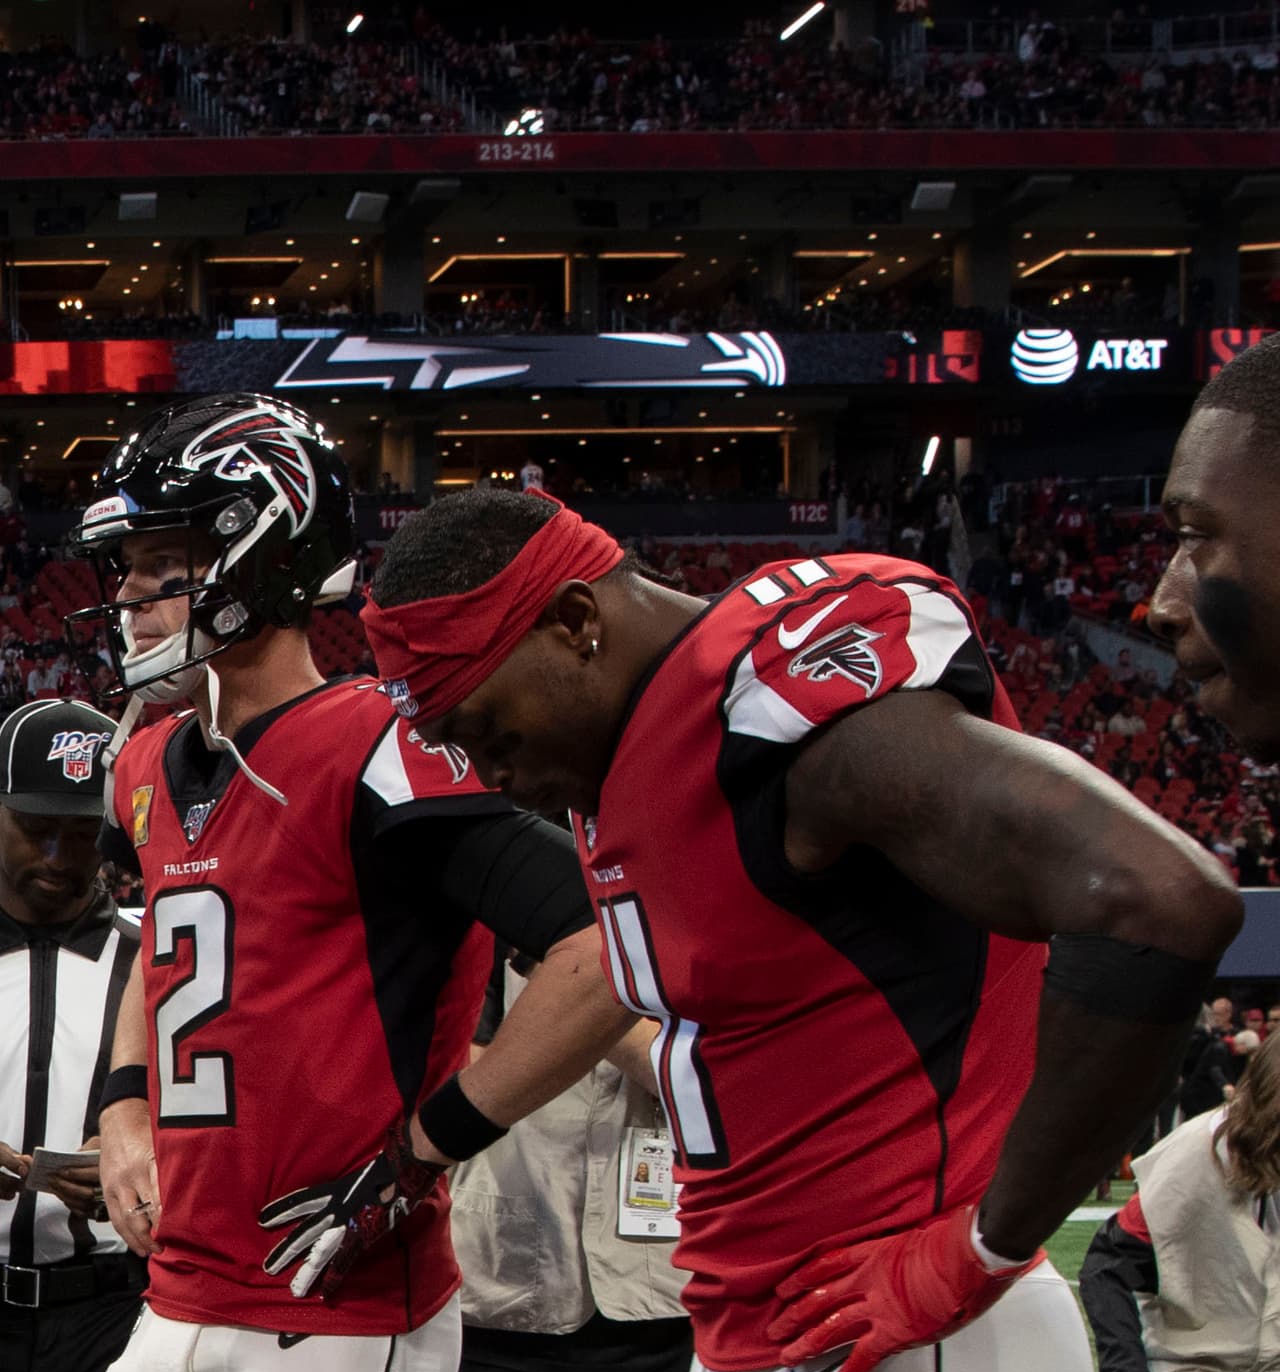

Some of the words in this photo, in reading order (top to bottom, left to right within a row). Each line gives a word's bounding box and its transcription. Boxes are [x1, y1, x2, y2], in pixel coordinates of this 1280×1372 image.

[479, 142, 556, 161] 213-214
[1086, 338, 1169, 371] AT&T
[788, 503, 828, 523] 112C
[66, 762, 91, 778] NFL
[163, 857, 219, 876] FALCONS
[151, 884, 237, 1129] 2
